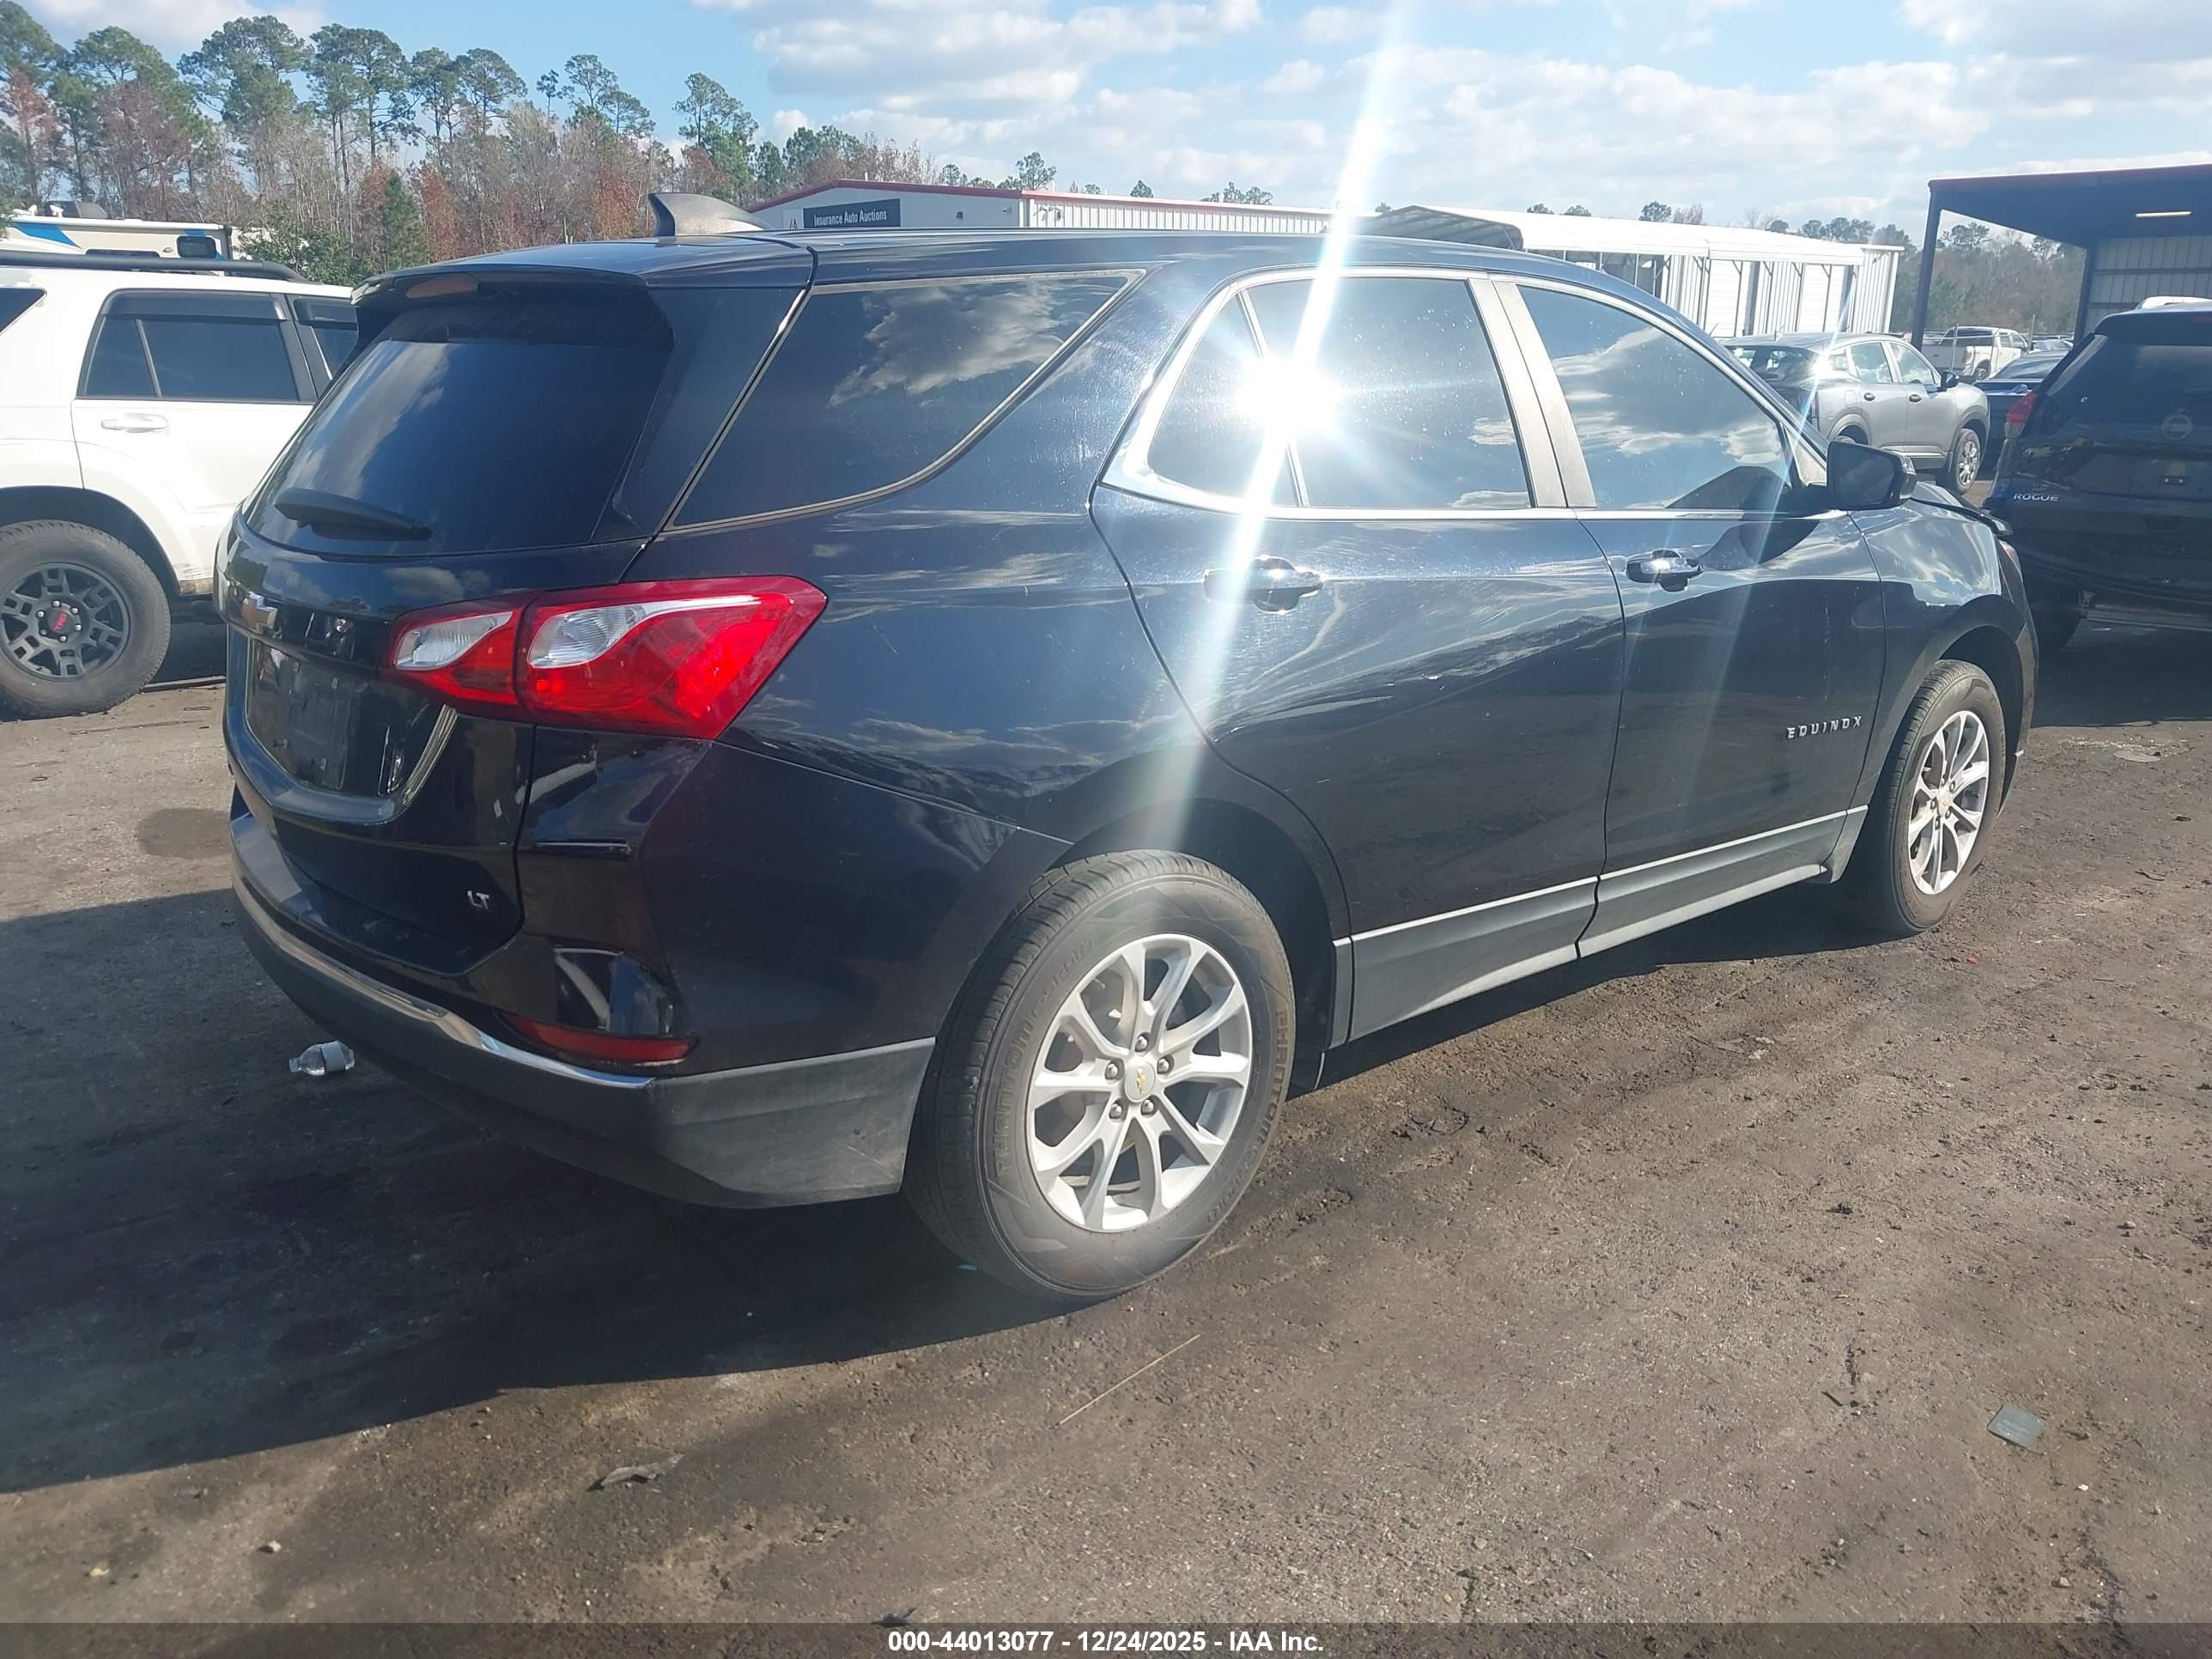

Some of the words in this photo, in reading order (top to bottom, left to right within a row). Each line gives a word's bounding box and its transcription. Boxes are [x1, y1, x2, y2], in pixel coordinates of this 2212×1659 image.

[813, 213, 842, 227] Insurance
[844, 210, 858, 223] Auto
[860, 208, 887, 222] Auctions
[2013, 493, 2060, 501] ROGUE
[1786, 715, 1862, 738] EQUINOX
[466, 890, 489, 910] LT
